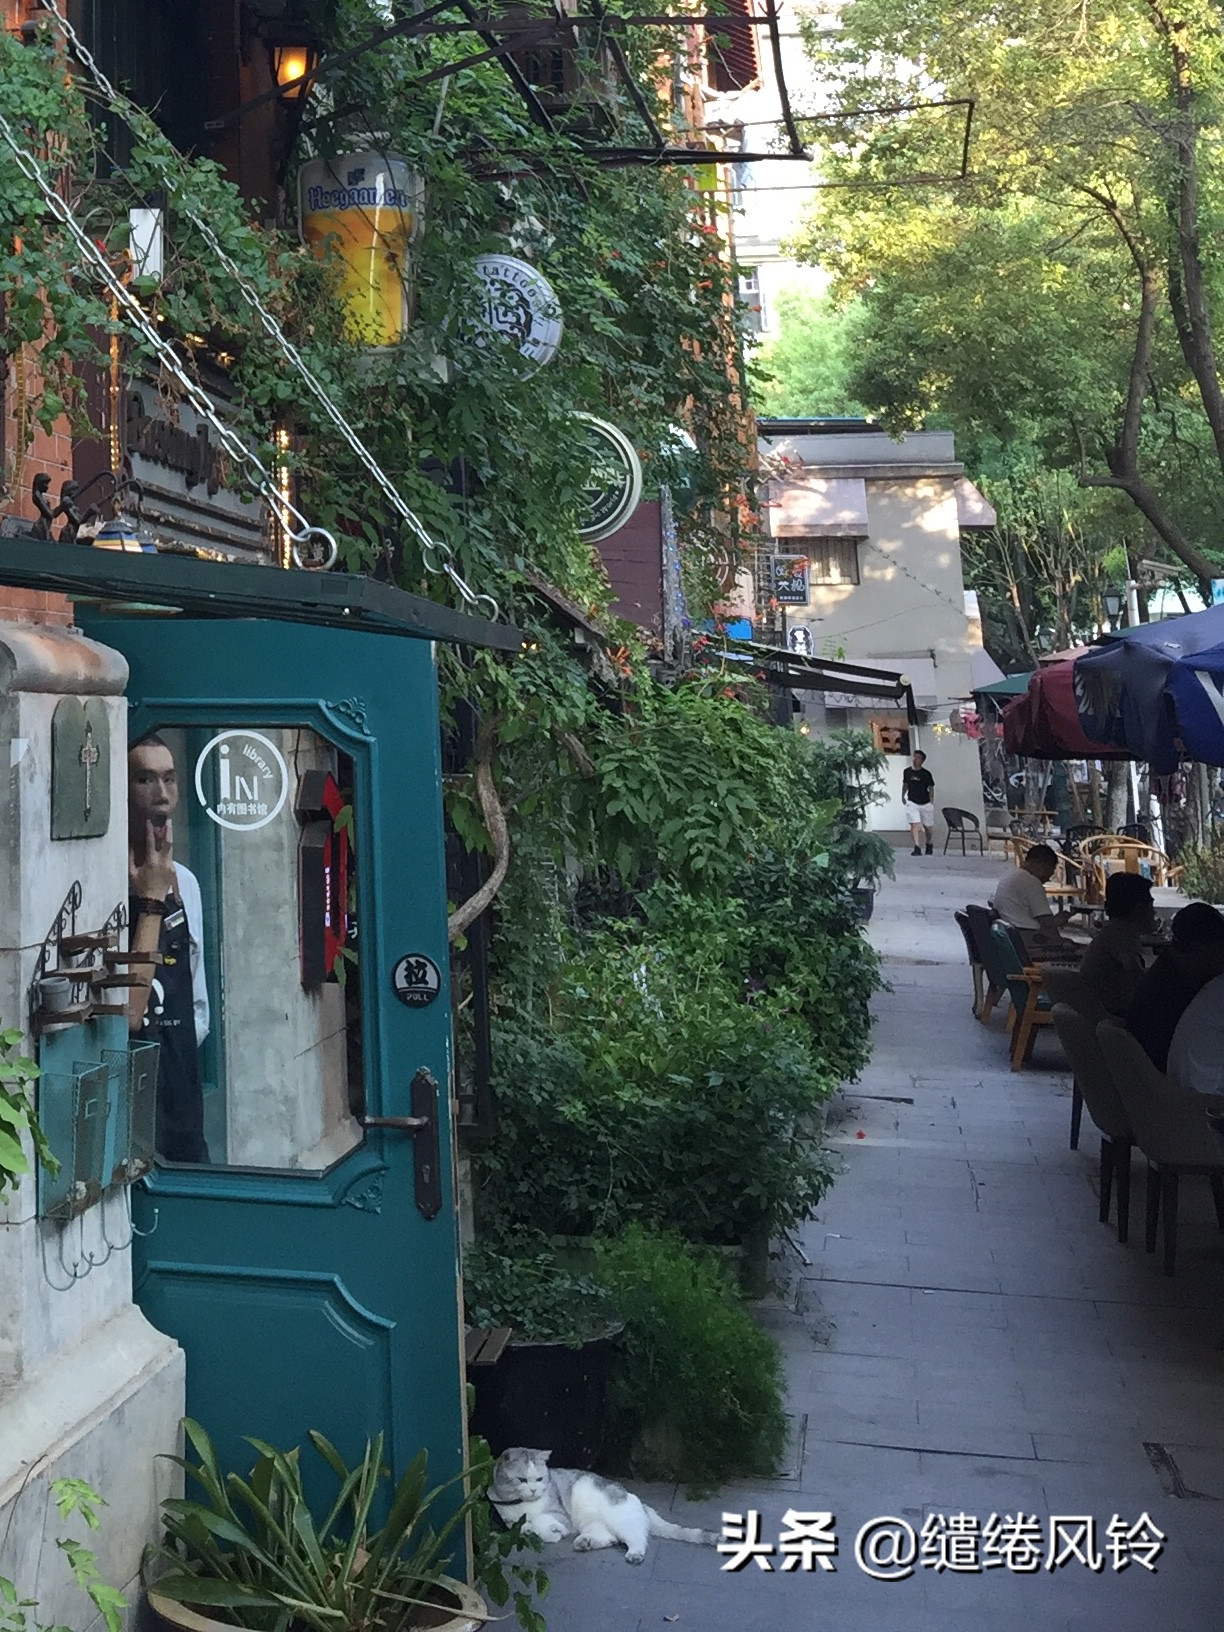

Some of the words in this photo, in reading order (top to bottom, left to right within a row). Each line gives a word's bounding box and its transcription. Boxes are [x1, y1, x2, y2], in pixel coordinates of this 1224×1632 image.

[242, 744, 274, 779] library
[216, 802, 268, 816] 内有图书馆
[404, 959, 429, 987] 拉
[406, 992, 429, 1002] PULL
